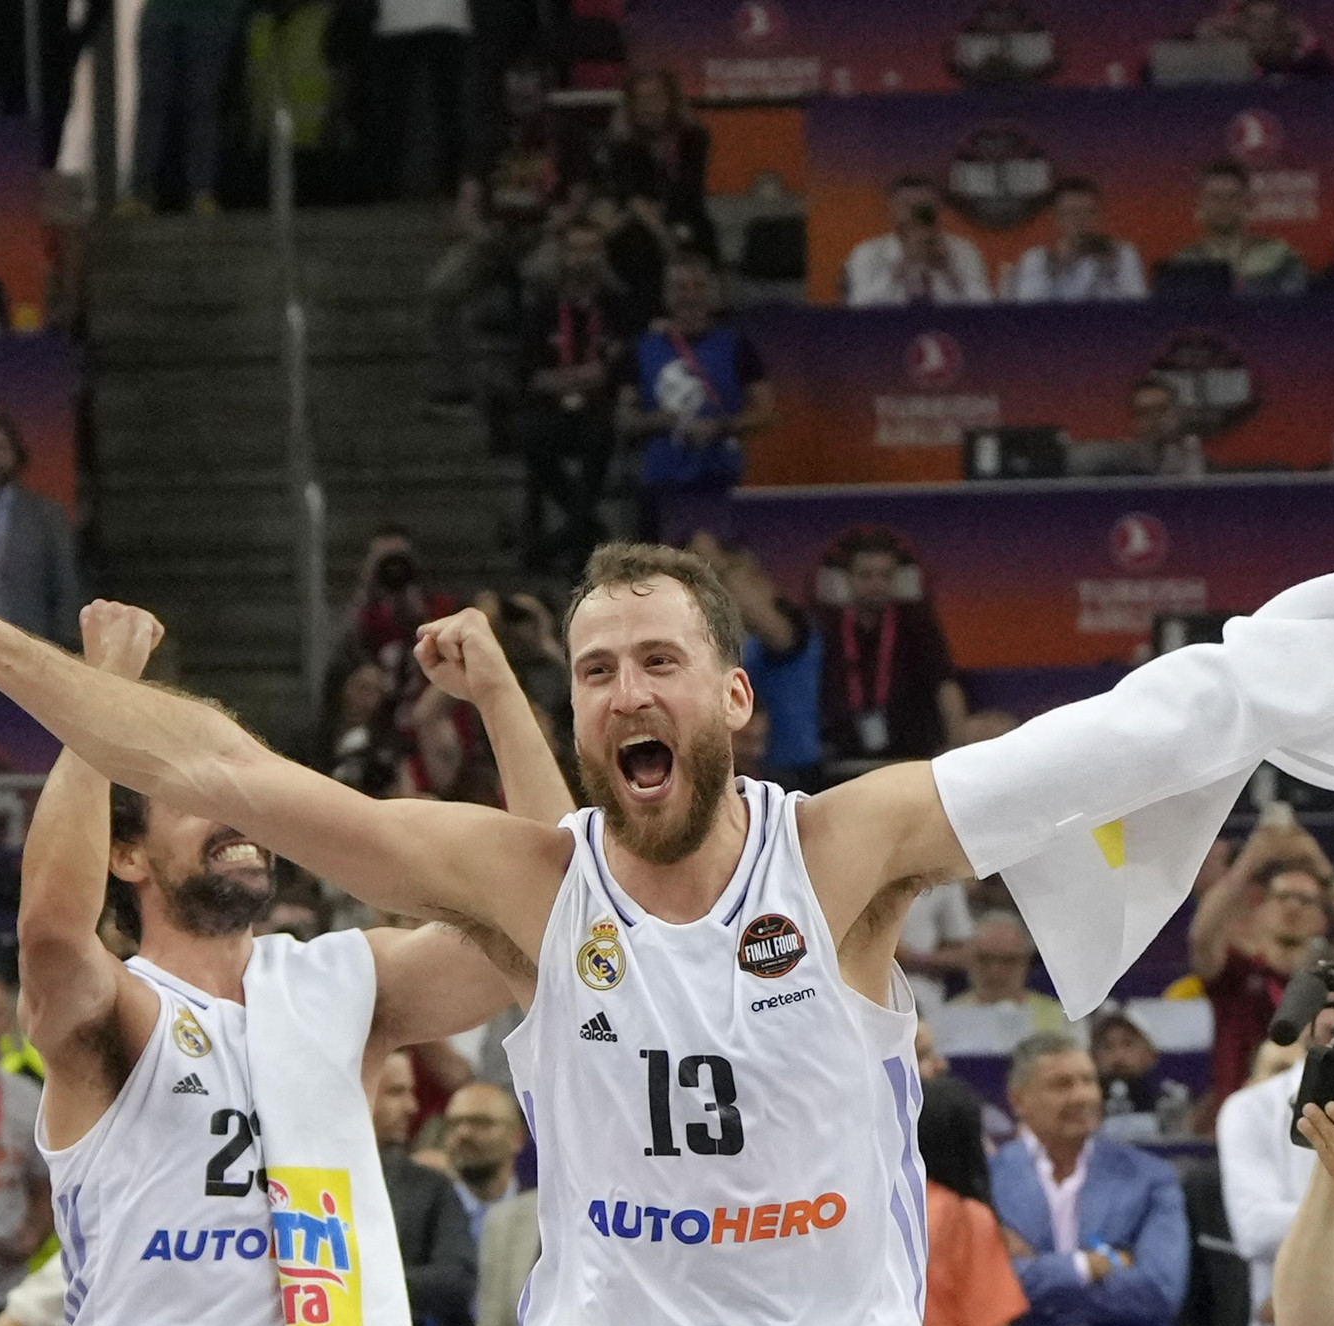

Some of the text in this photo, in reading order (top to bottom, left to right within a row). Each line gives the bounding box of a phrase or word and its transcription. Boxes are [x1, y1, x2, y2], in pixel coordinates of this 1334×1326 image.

[745, 939, 774, 963] FINAL
[772, 933, 799, 957] FOUR
[579, 1029, 618, 1043] adidas
[172, 1085, 209, 1096] adidas
[639, 1049, 745, 1156] 13
[588, 1192, 847, 1245] AUTOHERO
[140, 1227, 275, 1262] AUTO
